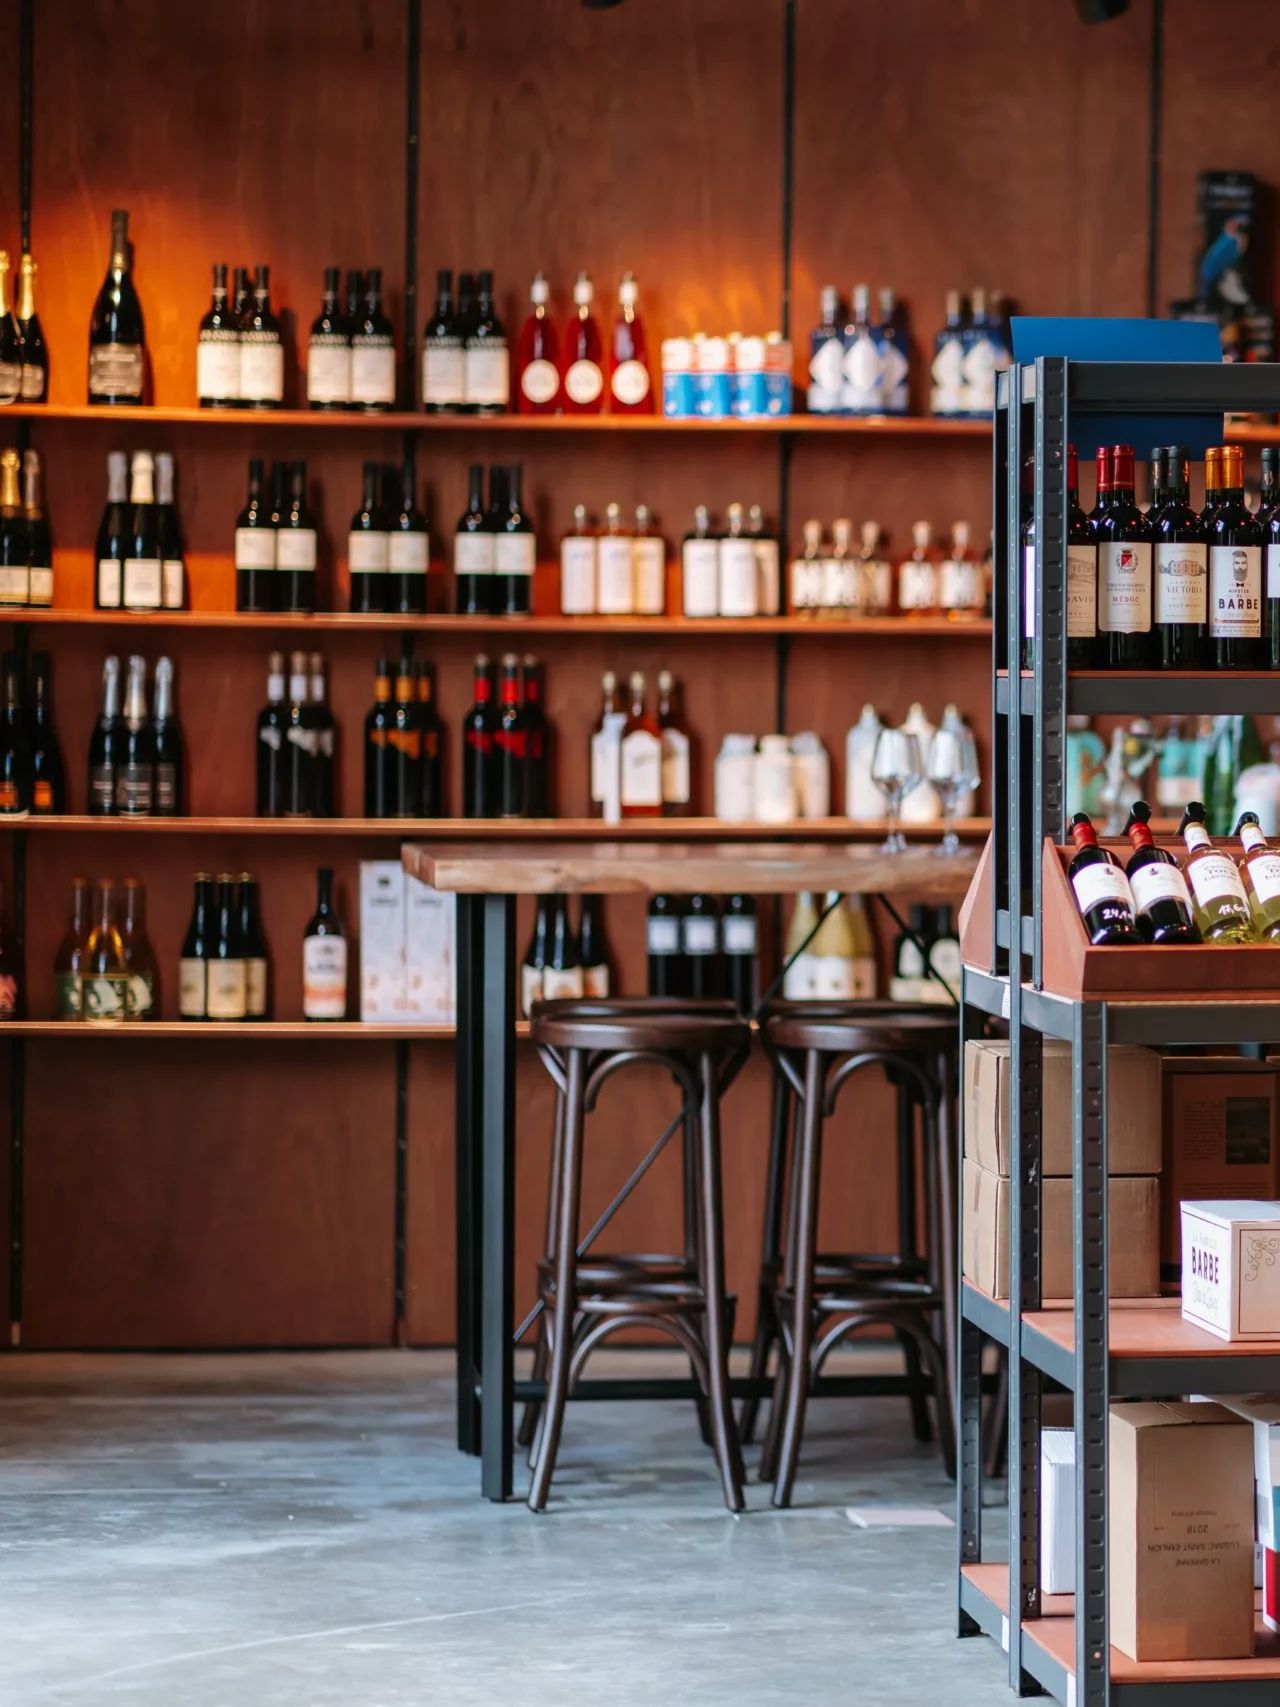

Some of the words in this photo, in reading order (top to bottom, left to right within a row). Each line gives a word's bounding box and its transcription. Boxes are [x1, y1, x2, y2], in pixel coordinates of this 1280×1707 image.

[1167, 586, 1203, 594] VICTORIA
[1218, 598, 1258, 609] BARBE
[1192, 1246, 1219, 1285] BARBE
[1186, 1524, 1208, 1534] 2018
[1209, 1541, 1240, 1550] LUSSAC
